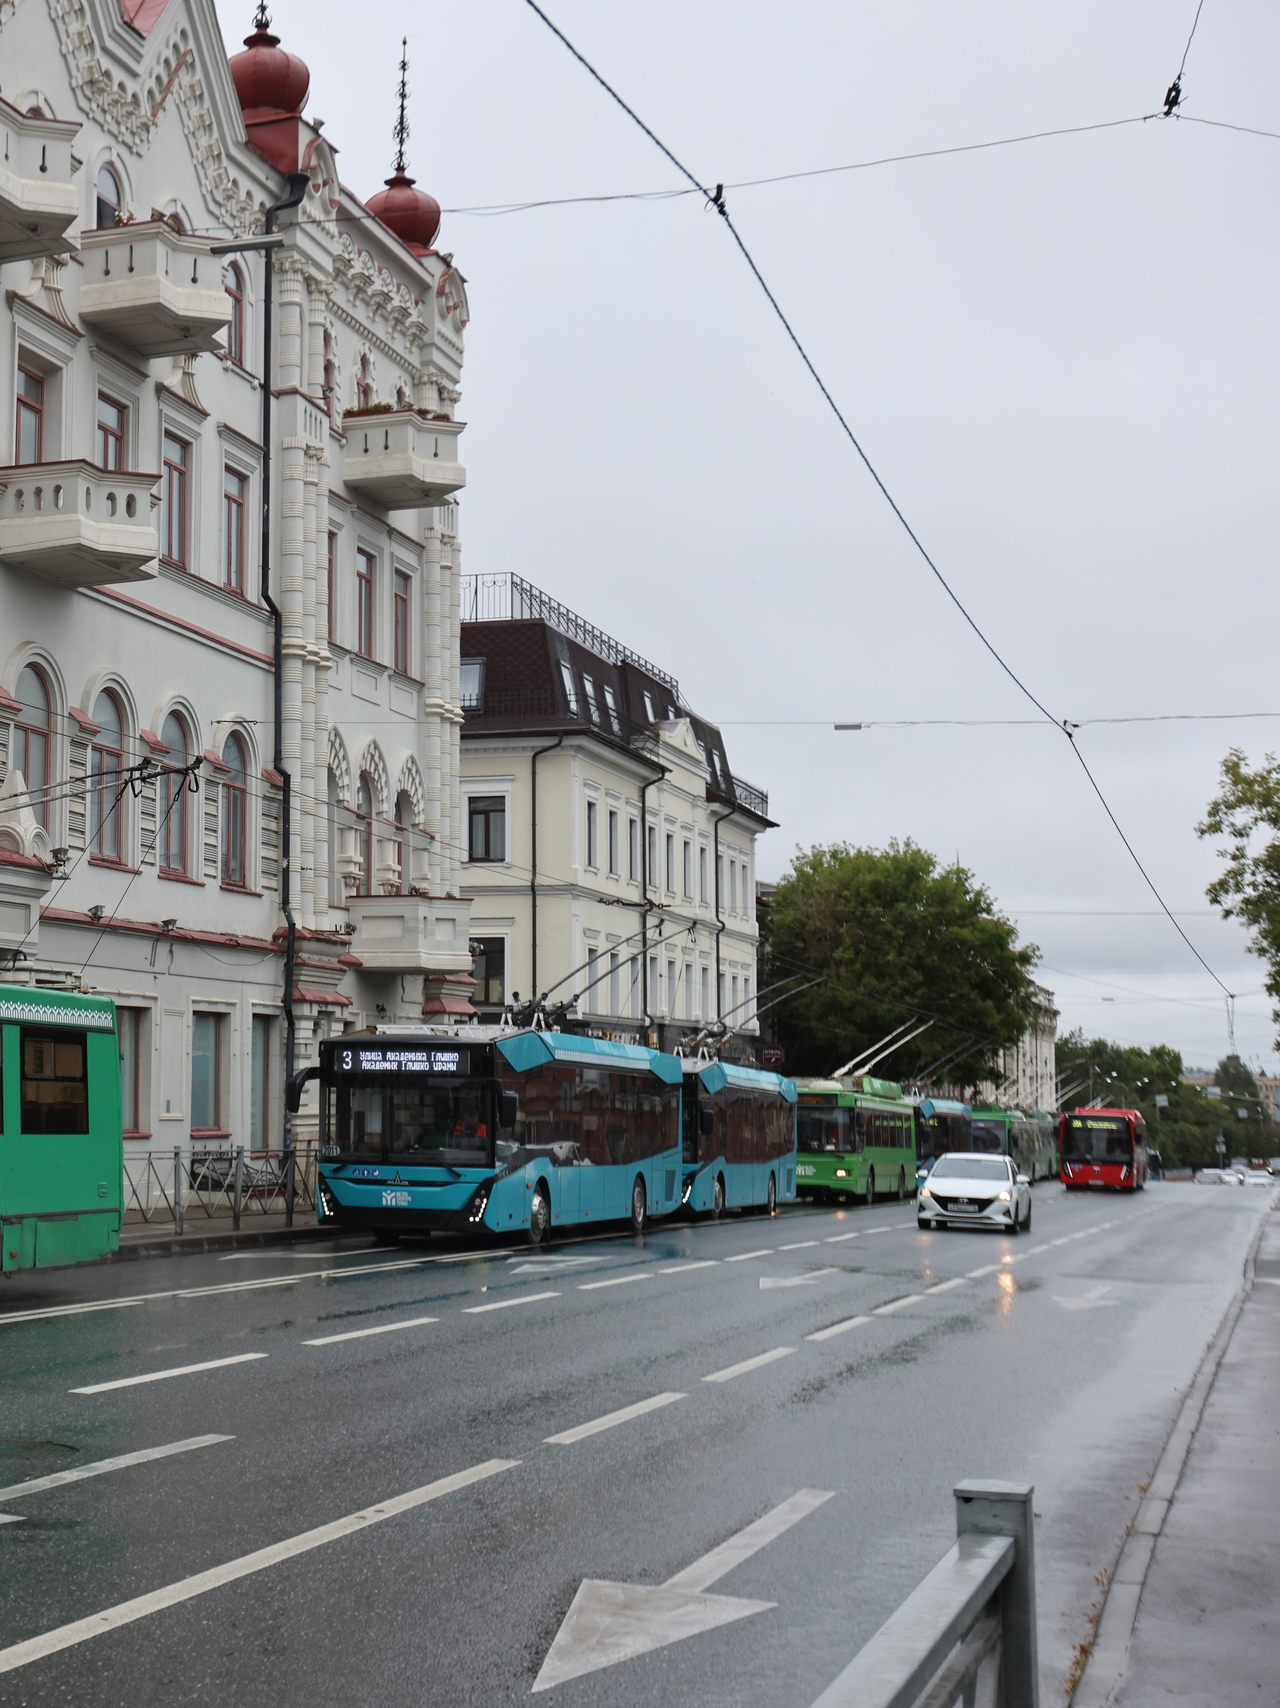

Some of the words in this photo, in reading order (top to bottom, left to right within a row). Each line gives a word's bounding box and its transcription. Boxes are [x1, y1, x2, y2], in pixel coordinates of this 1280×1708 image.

[342, 1051, 352, 1069] 3
[360, 1051, 383, 1061] Улица
[386, 1051, 428, 1061] Академика
[431, 1052, 459, 1062] Глушко
[362, 1061, 399, 1070] Академик
[401, 1061, 430, 1071] Глушко
[323, 1145, 338, 1156] 2011
